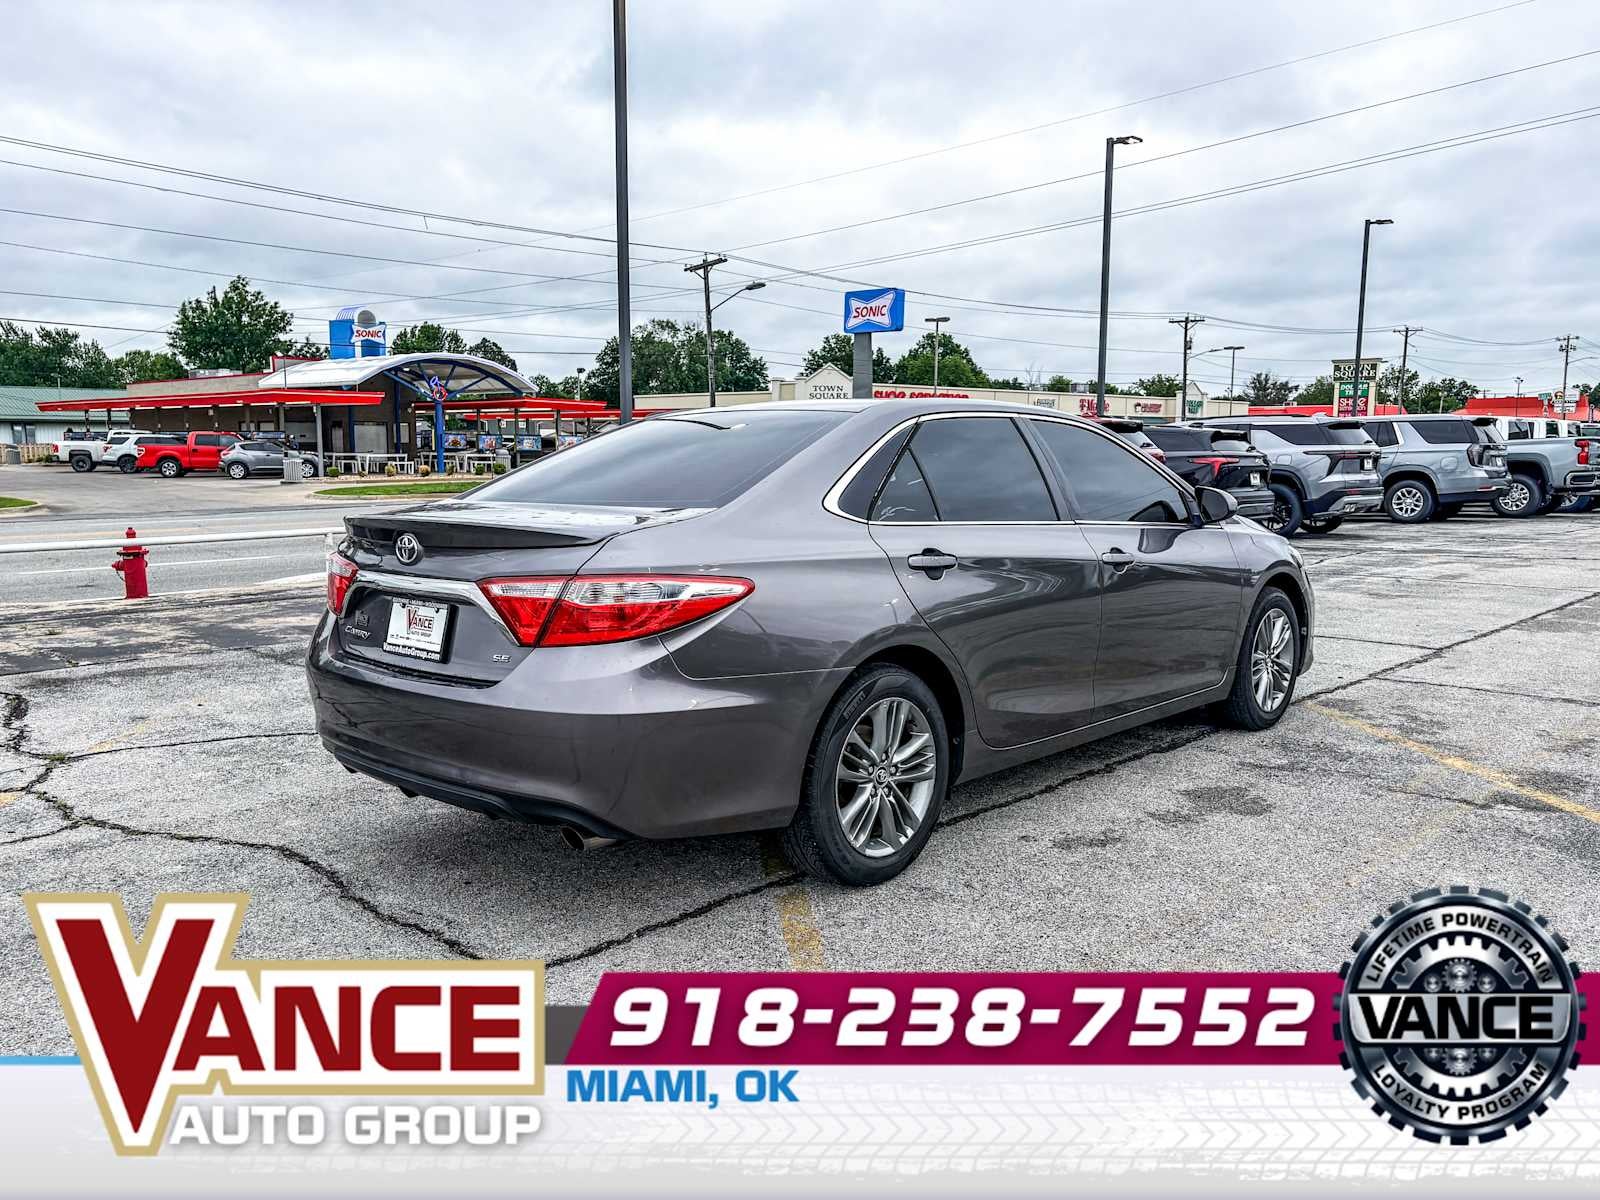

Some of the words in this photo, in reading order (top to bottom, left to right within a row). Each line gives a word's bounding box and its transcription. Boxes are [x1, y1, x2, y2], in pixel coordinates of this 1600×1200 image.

[853, 305, 886, 319] SONIC
[355, 330, 382, 339] SONIC
[407, 607, 433, 630] VANCE
[493, 655, 511, 663] SE
